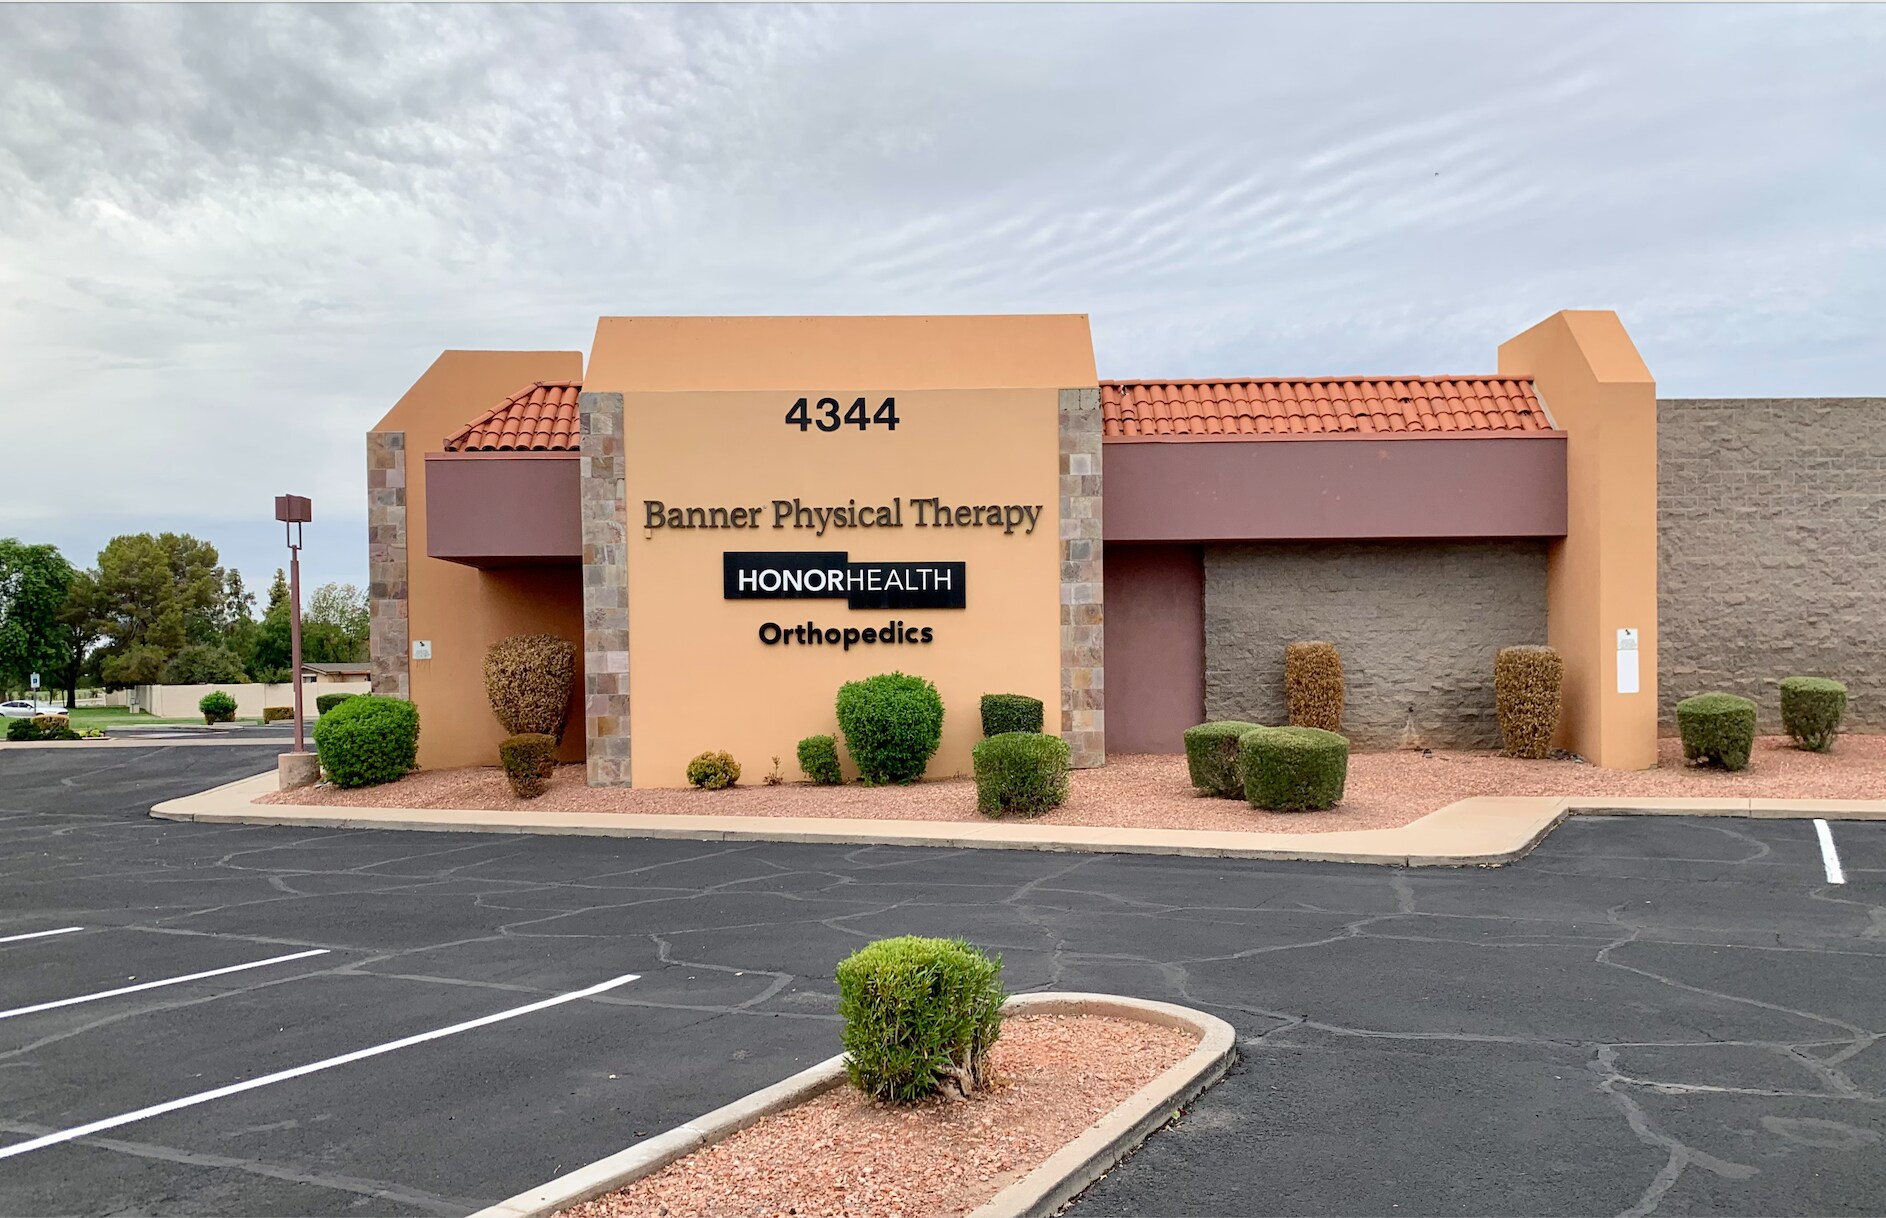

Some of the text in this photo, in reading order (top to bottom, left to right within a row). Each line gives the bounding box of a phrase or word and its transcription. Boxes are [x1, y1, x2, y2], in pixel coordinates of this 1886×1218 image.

[785, 397, 900, 432] 4344
[643, 497, 1042, 537] Banner Physical Therapy
[738, 568, 952, 592] HONORHEALTH
[758, 621, 933, 651] Orthopedics
